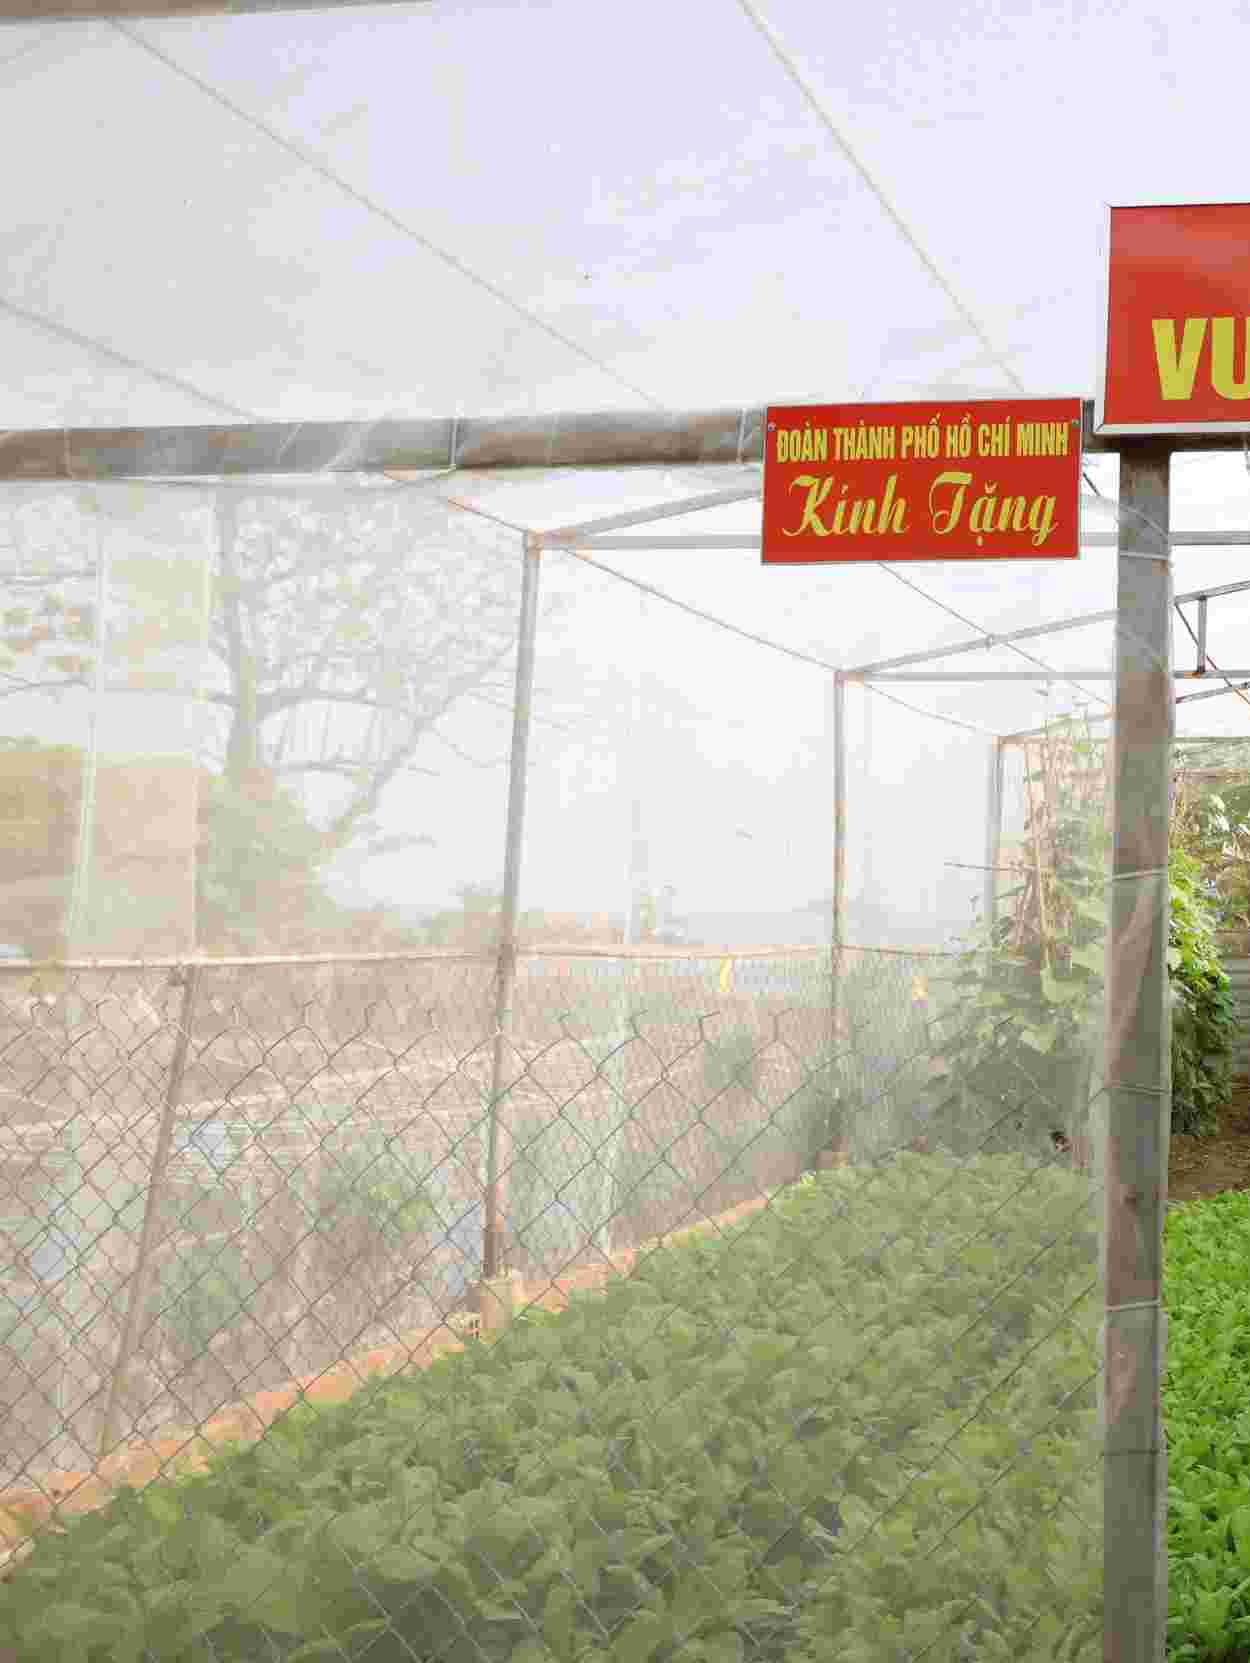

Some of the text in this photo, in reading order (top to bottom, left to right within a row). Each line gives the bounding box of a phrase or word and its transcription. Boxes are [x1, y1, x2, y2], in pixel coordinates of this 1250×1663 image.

[776, 412, 1069, 463] ĐOÀN THÀNH PHỐ HỒ CHÍ MINH
[782, 471, 1058, 546] Kính Tặng
